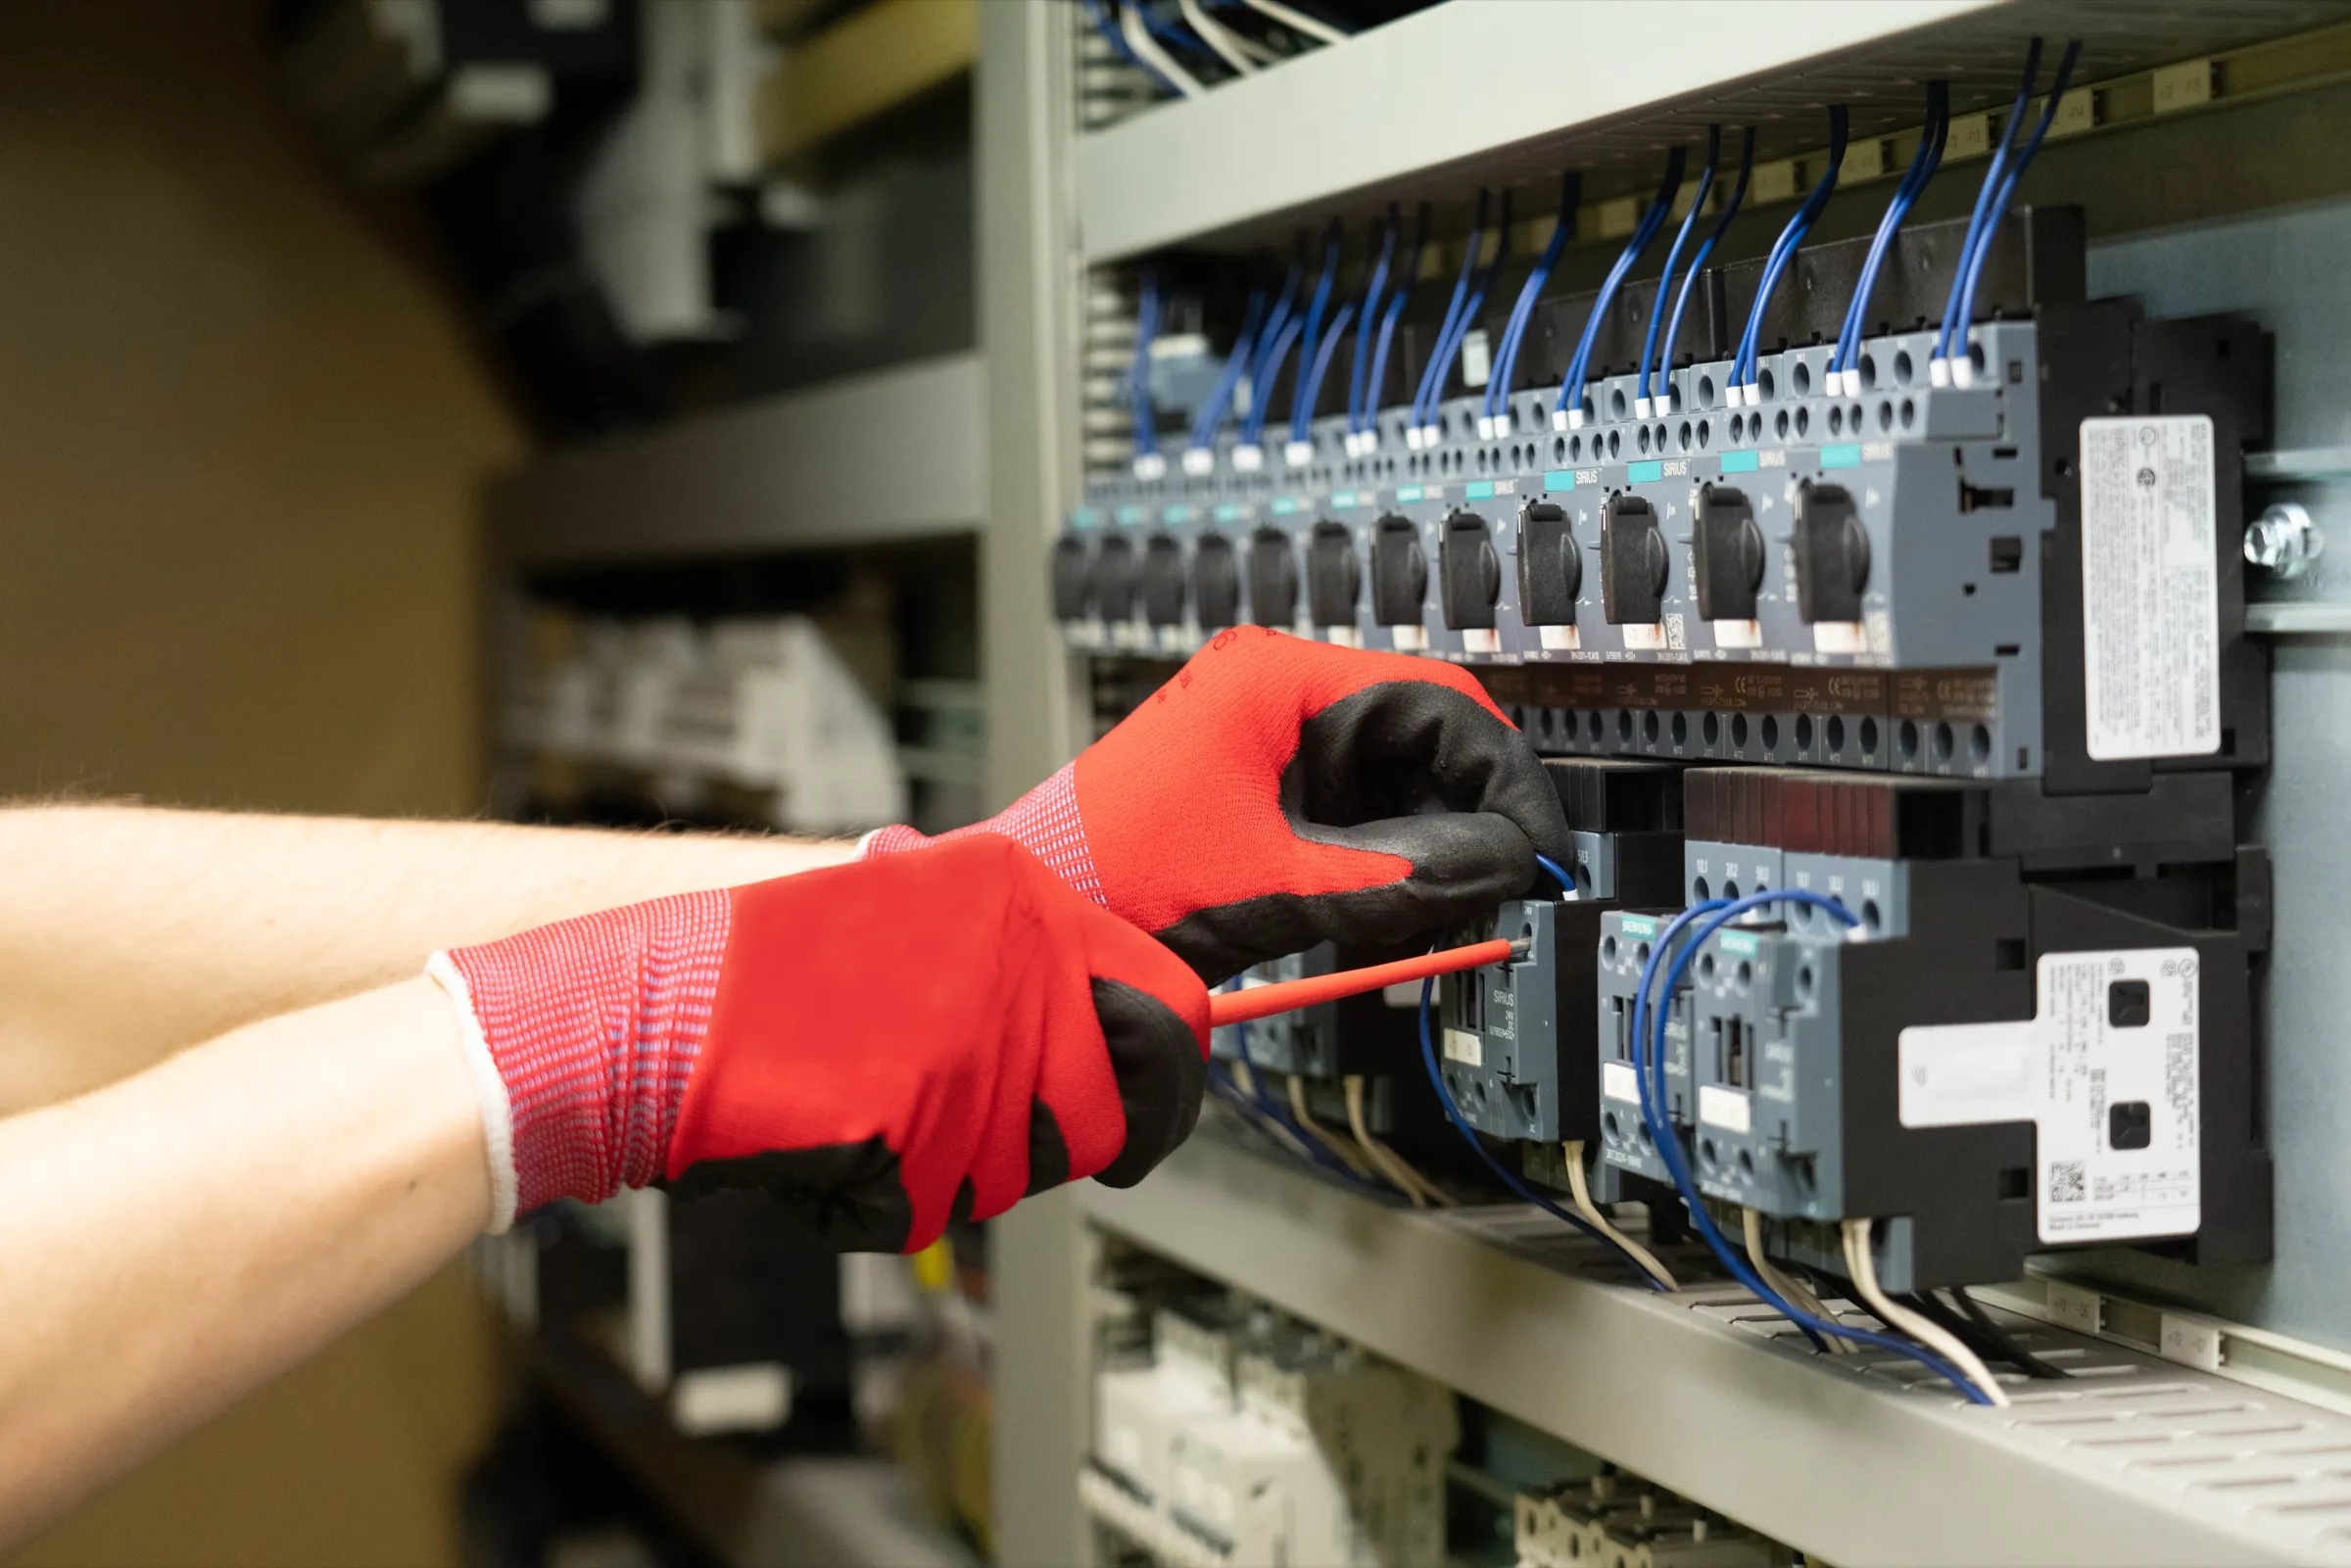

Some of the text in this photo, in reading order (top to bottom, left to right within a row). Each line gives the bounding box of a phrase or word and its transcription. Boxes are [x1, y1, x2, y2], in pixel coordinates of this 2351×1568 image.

[1663, 461, 1688, 477] SIRIUS
[1575, 470, 1598, 485] SIRIUS
[1493, 989, 1514, 1006] SIRIUS
